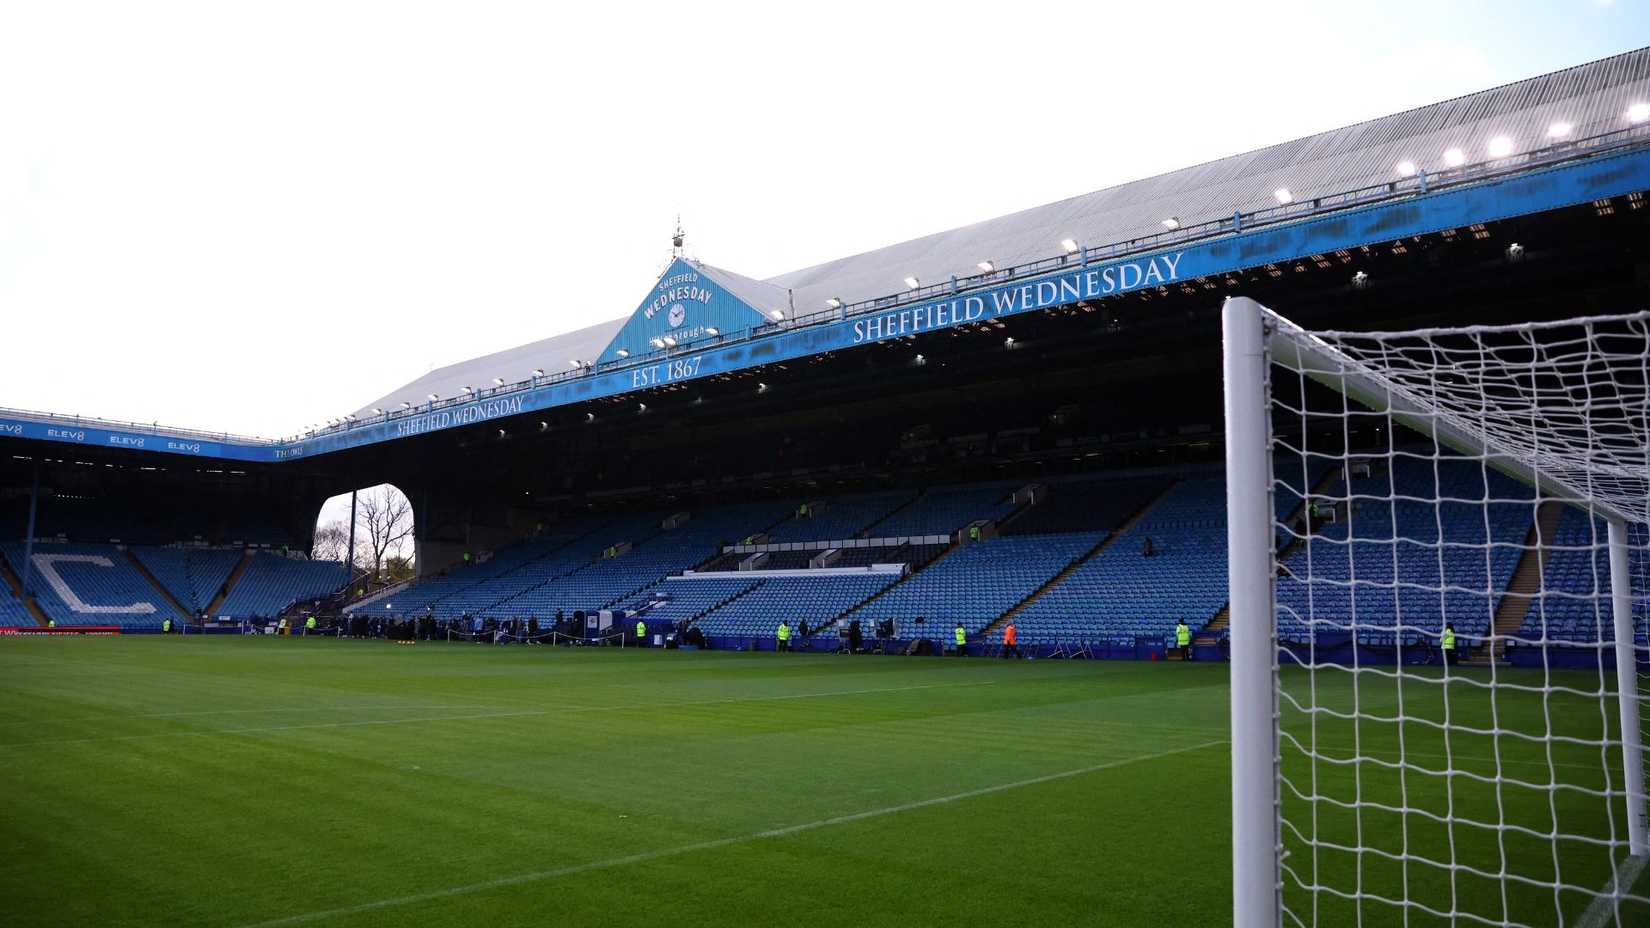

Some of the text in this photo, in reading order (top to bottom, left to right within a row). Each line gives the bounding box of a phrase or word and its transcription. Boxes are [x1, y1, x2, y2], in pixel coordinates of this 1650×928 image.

[659, 273, 698, 292] SHEFFIELD
[644, 286, 712, 320] WEDNESDAY
[853, 253, 1183, 344] SHEFFIELD WEDNESDAY
[632, 356, 702, 388] EST. 1867
[397, 395, 525, 436] SHEFFIELD WEDNESDAY
[47, 429, 85, 441] ELEV8
[110, 436, 145, 447] ELEV8
[168, 442, 201, 453] ELEV8
